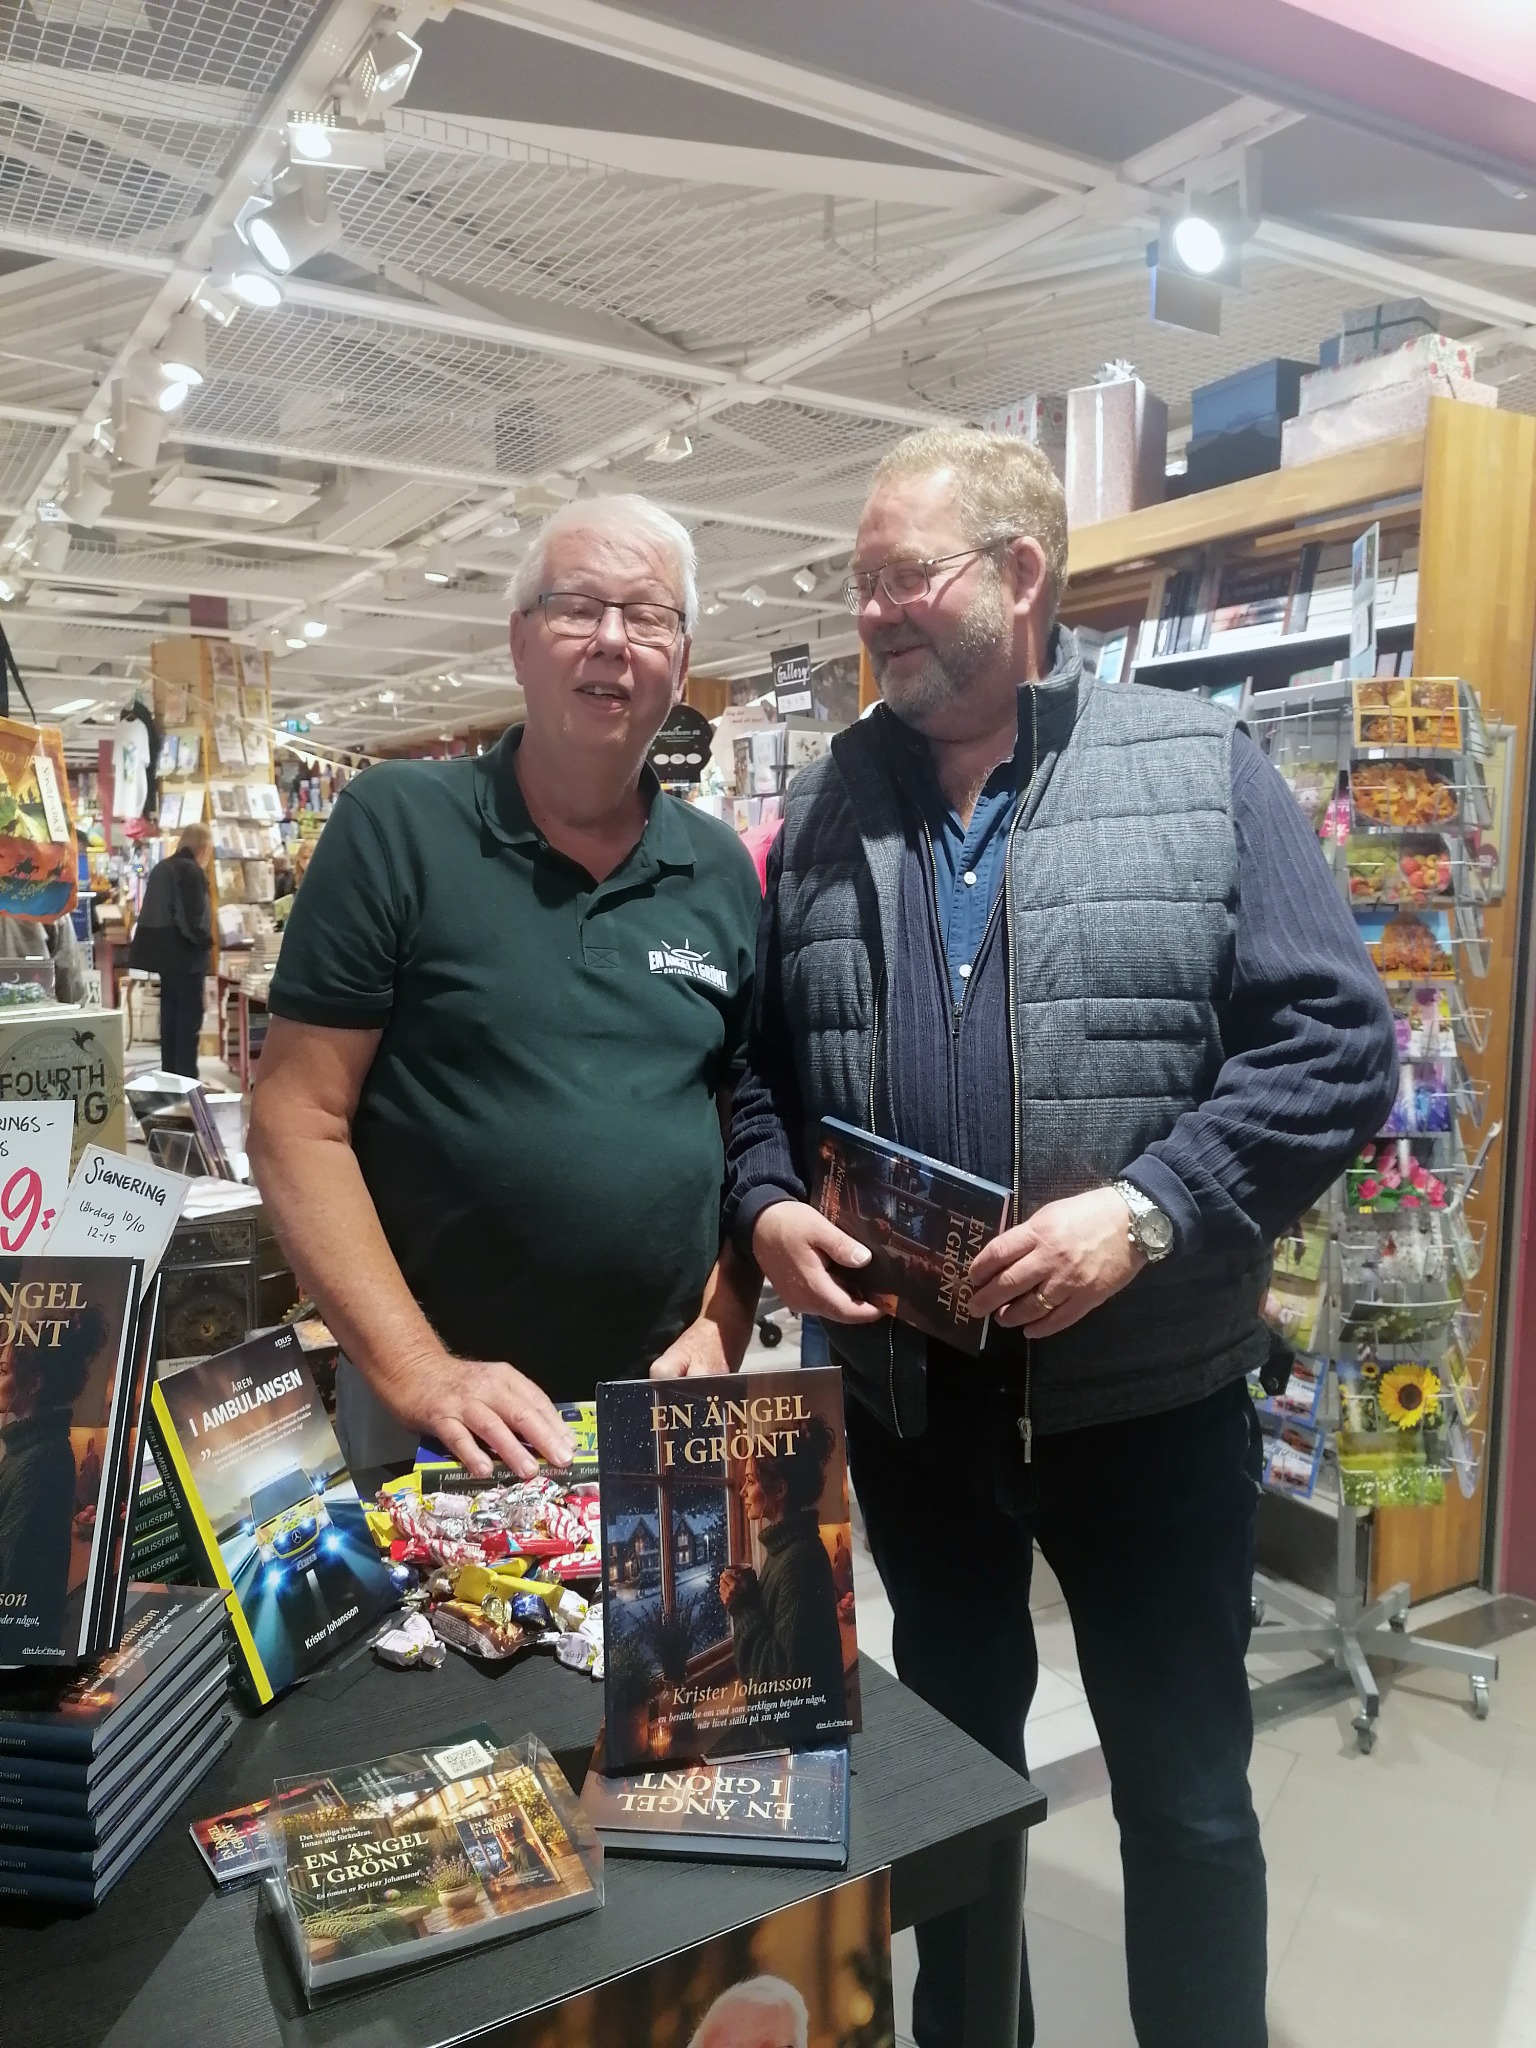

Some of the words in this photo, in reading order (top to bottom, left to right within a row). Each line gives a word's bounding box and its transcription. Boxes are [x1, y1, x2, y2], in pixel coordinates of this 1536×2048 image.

[0, 1064, 105, 1099] FOURTH
[87, 1226, 117, 1244] 12-15
[122, 1210, 146, 1234] 10/10
[950, 1216, 965, 1229] I
[937, 1231, 962, 1312] GRÖNT
[231, 1376, 253, 1394] ÅREN
[189, 1418, 199, 1438] I
[202, 1368, 303, 1433] AMBULANSEN
[650, 1403, 695, 1432] EN
[702, 1395, 811, 1428] ÄNGEL
[664, 1441, 676, 1466] I
[684, 1429, 800, 1464] GRÖNT
[16, 1614, 40, 1628] något,
[304, 1628, 327, 1650] Krister
[326, 1605, 359, 1636] Johansson
[672, 1686, 728, 1706] Krister
[732, 1676, 813, 1700] Johansson
[668, 1710, 702, 1722] berättelse
[703, 1710, 715, 1718] om
[716, 1705, 730, 1716] vad
[731, 1706, 746, 1715] som
[747, 1699, 778, 1715] verkligen
[779, 1696, 804, 1710] betyder
[805, 1693, 827, 1706] något,
[697, 1720, 710, 1730] när
[711, 1716, 728, 1728] livet
[729, 1715, 748, 1727] ställs
[749, 1714, 760, 1726] på
[760, 1712, 772, 1722] sin
[773, 1710, 791, 1723] spets
[634, 1772, 762, 1796] GRÖNT
[770, 1779, 783, 1796] I
[617, 1794, 740, 1821] ÄNGEL
[746, 1802, 794, 1820] EN
[303, 1850, 339, 1871] EN
[347, 1832, 429, 1862] ÄNGEL
[308, 1873, 321, 1888] I
[326, 1851, 413, 1883] GRÖNT
[326, 1888, 348, 1898] roman
[357, 1880, 383, 1891] Krister
[382, 1869, 421, 1887] Johansson
